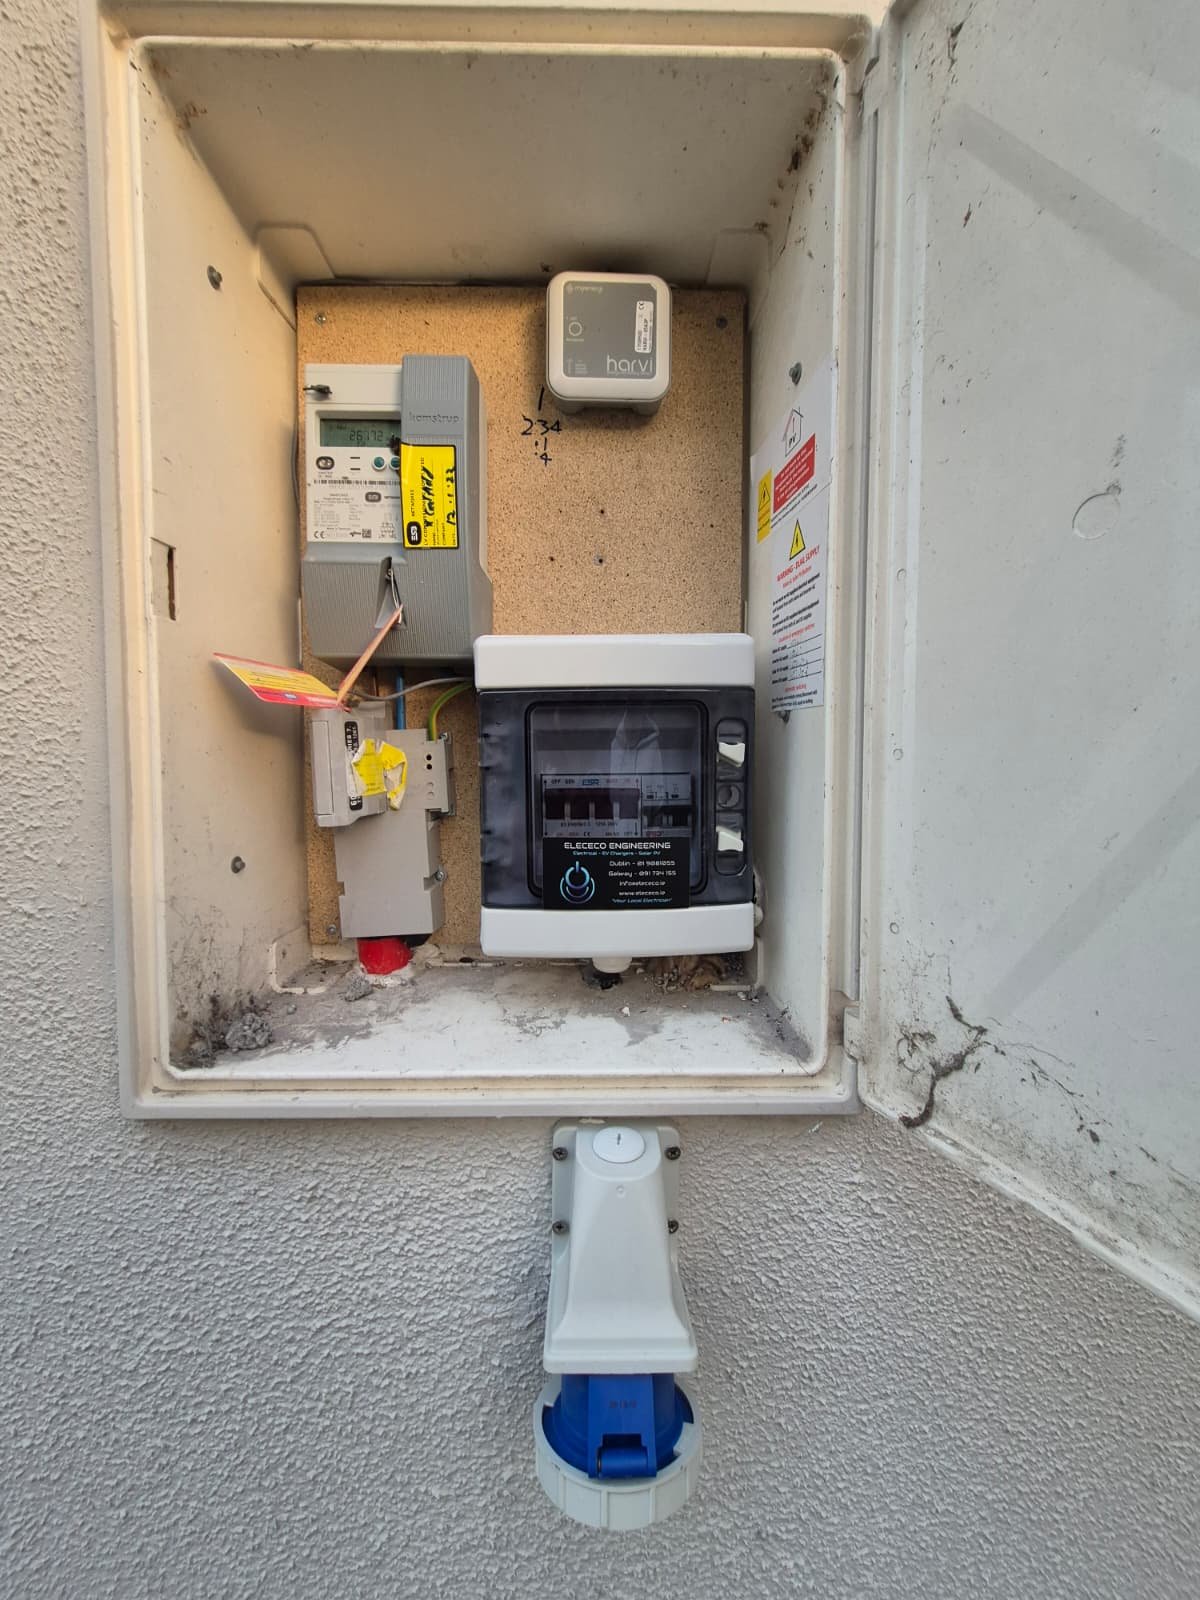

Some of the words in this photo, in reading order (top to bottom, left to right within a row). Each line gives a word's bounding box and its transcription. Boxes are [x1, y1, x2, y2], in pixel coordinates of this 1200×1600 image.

[606, 355, 653, 372] harvi
[521, 415, 562, 436] 234
[564, 842, 607, 850] ELECECO
[609, 842, 671, 850] ENGINEERING
[608, 870, 633, 878] Galway
